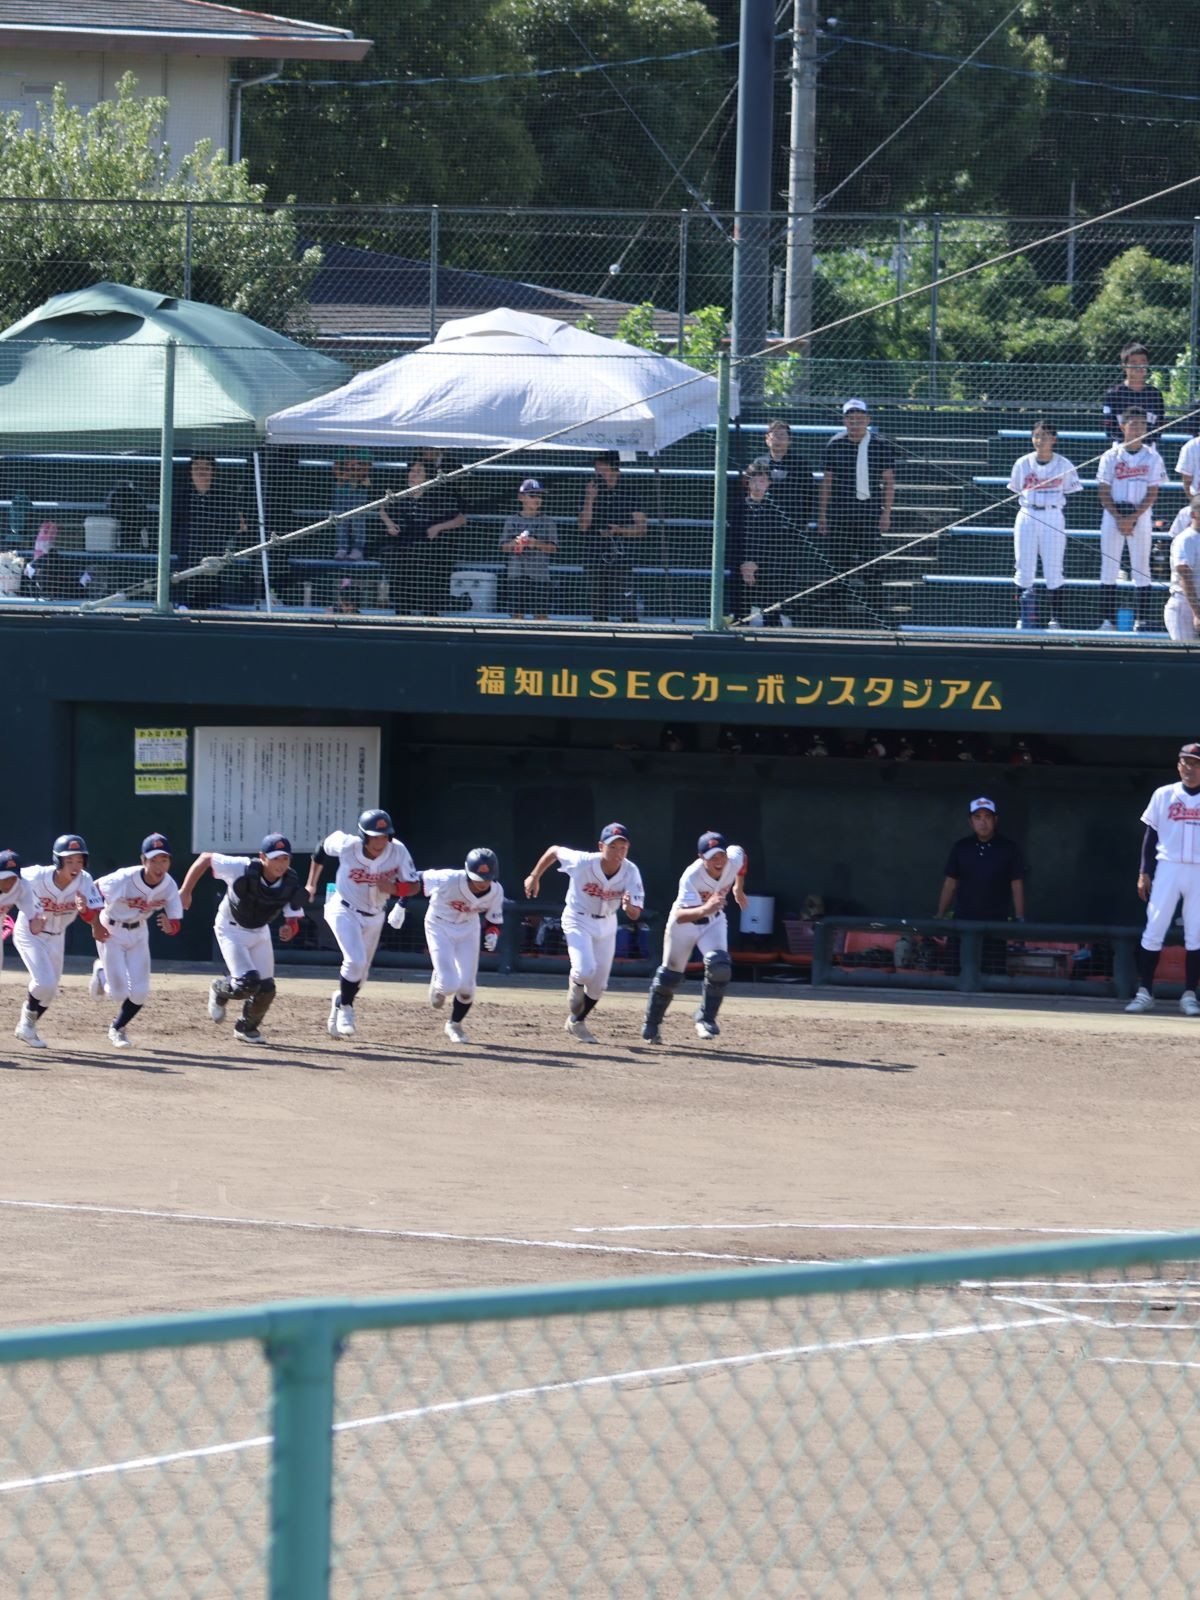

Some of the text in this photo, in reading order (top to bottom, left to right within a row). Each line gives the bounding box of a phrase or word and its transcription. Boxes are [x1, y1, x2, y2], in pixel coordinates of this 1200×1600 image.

[476, 666, 1003, 711] 福知山SECカーボンスタジアム
